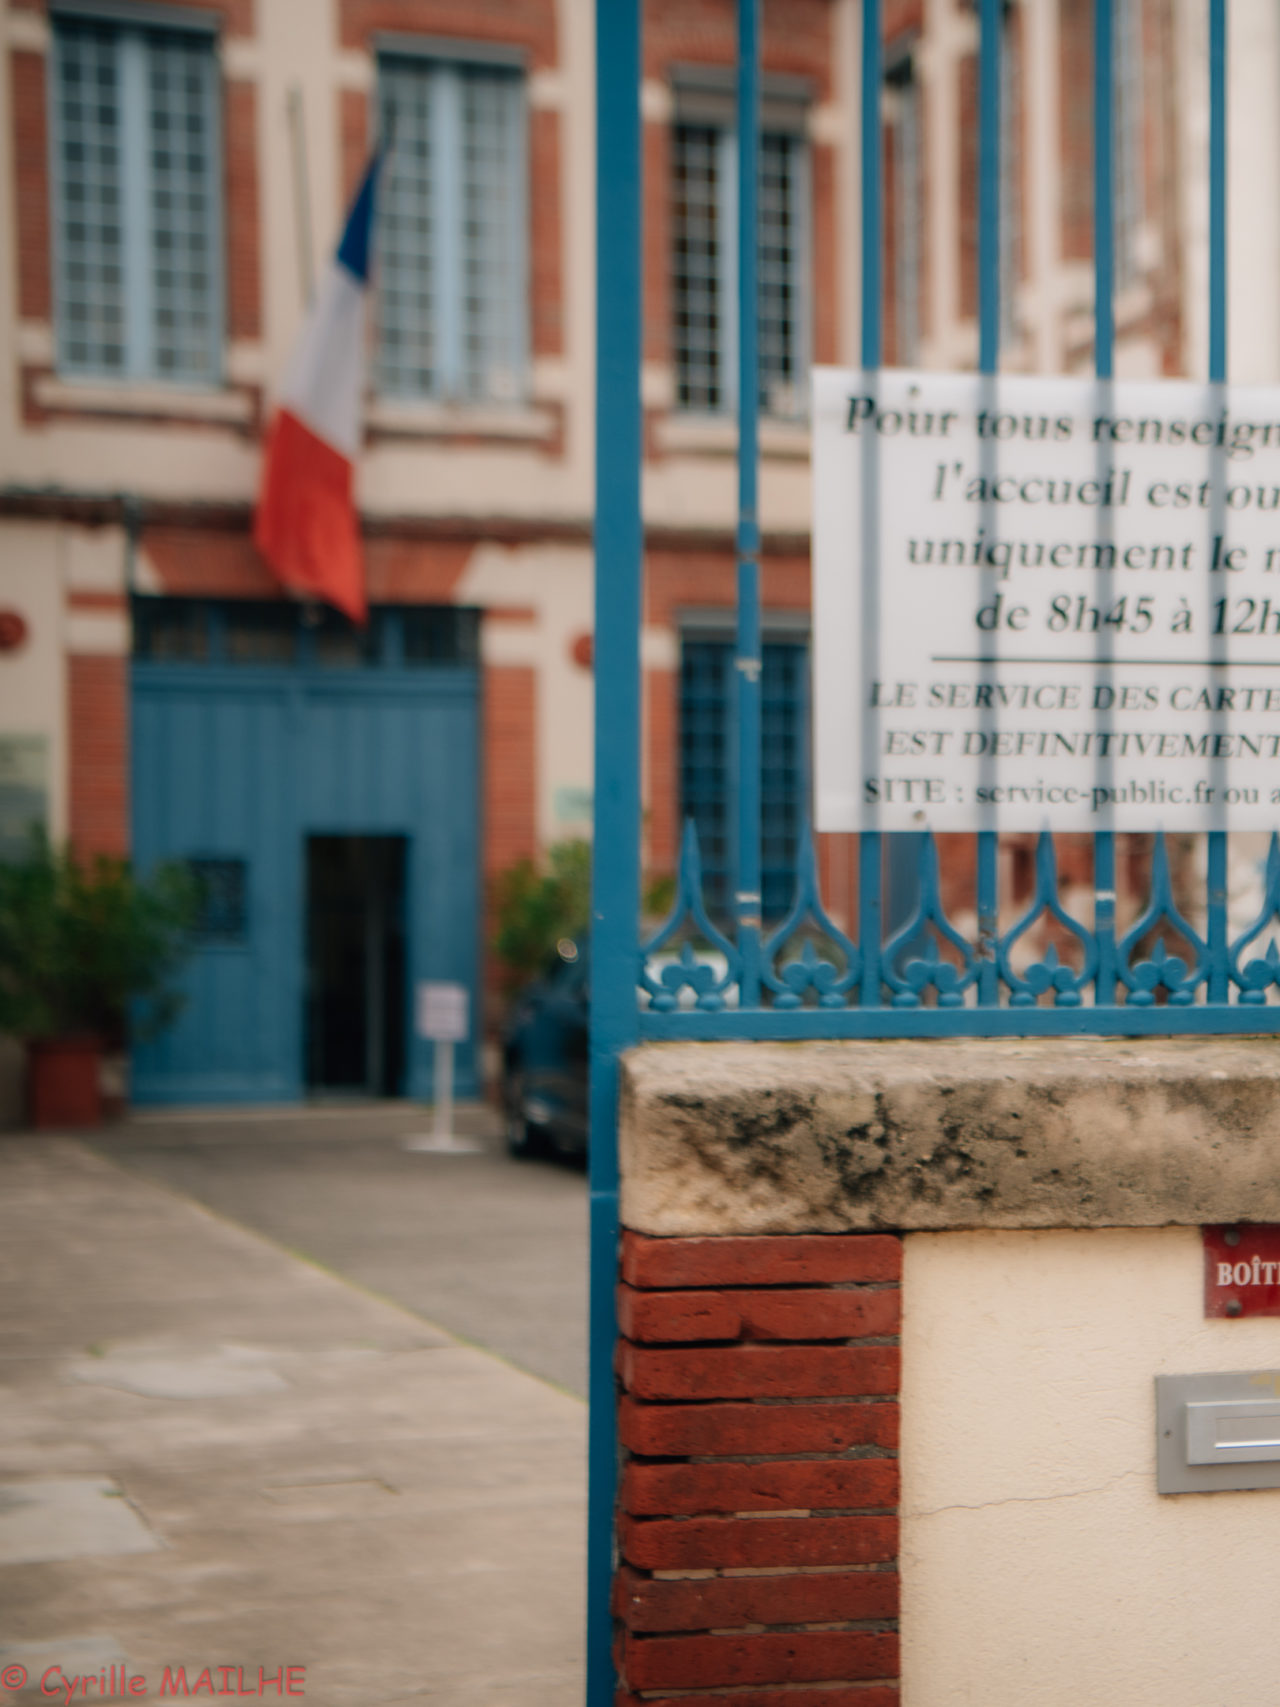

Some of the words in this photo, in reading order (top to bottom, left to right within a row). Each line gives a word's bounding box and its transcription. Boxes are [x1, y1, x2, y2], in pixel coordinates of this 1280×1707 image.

[844, 396, 957, 436] Pour
[976, 410, 1072, 441] tous
[932, 461, 1132, 507] l'accueil
[1147, 479, 1212, 508] est
[907, 527, 1194, 580] uniquement
[1209, 535, 1248, 572] le
[974, 593, 1031, 631] de
[1046, 594, 1155, 633] 8h45
[1170, 597, 1194, 634] à
[868, 682, 918, 708] LE
[927, 682, 1081, 710] SERVICE
[1090, 684, 1161, 711] DES
[884, 729, 954, 756] EST
[864, 777, 947, 804] SITE
[975, 778, 1216, 813] service-public.fr
[1222, 786, 1260, 805] ou
